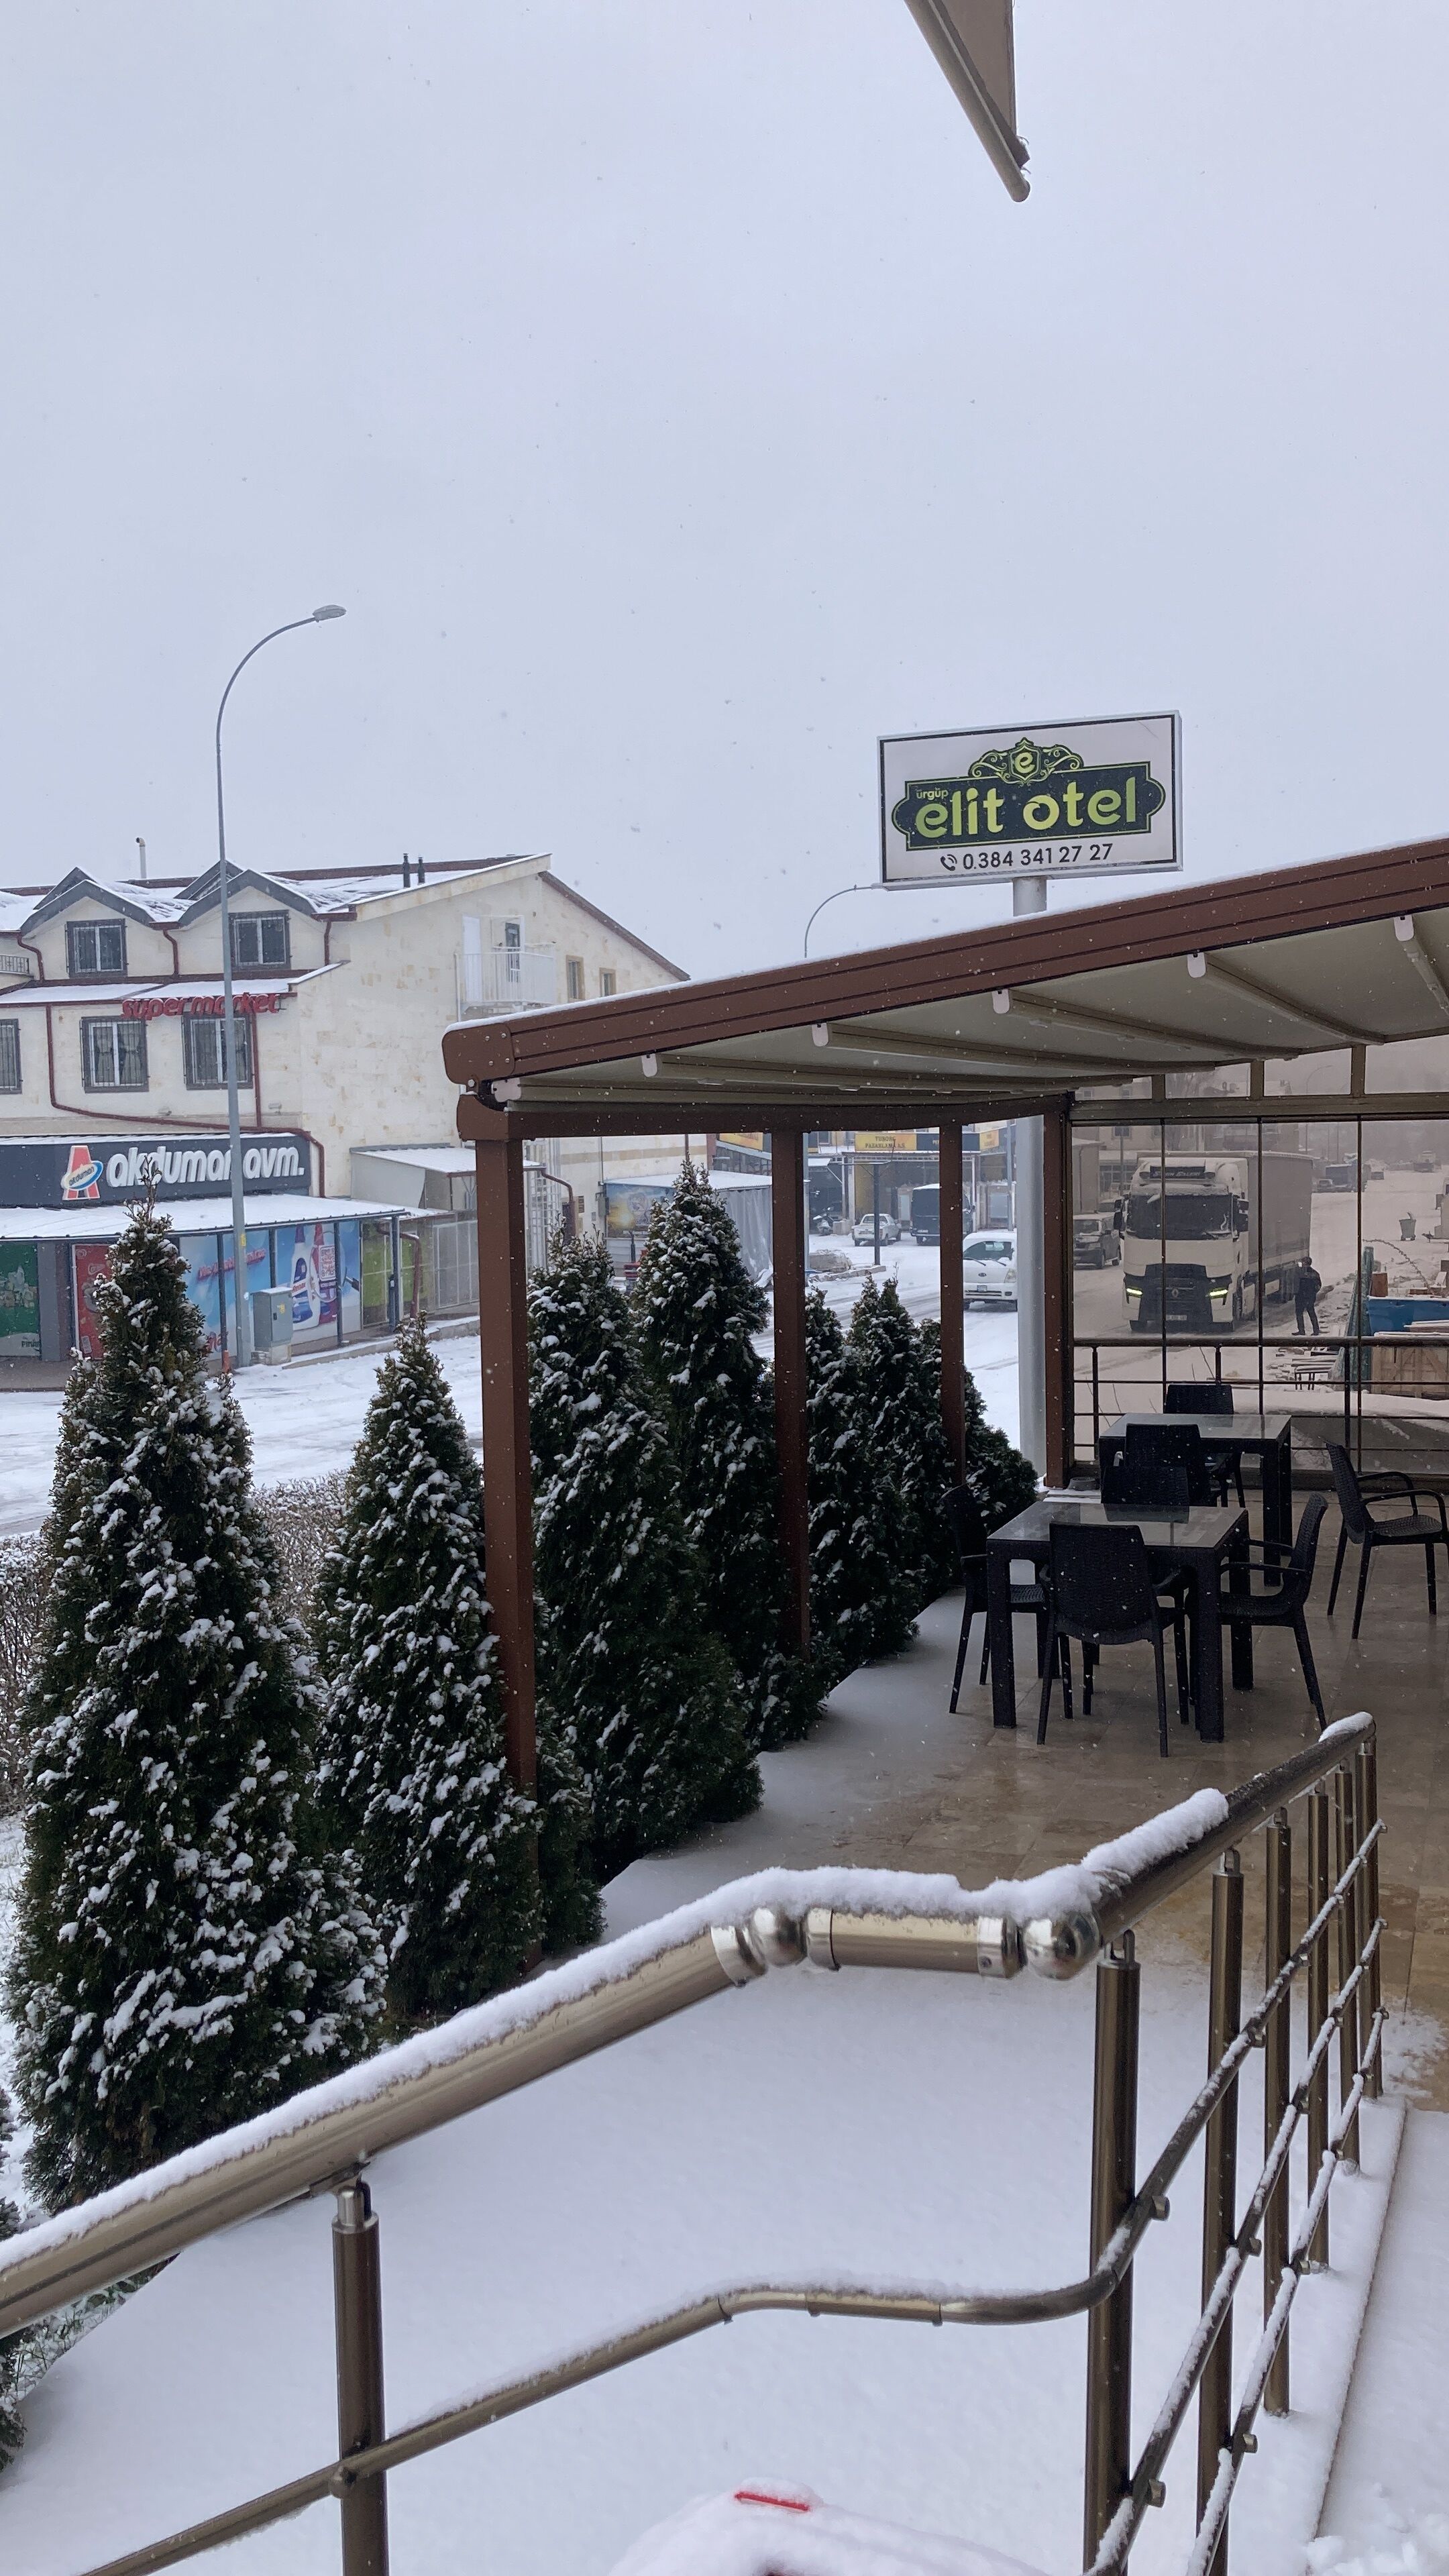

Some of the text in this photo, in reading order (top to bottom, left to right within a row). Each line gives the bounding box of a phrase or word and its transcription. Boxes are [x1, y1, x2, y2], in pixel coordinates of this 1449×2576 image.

[916, 777, 1136, 838] elit otel
[963, 843, 1113, 870] 0.384 341 27 27
[242, 1146, 308, 1179] avm.
